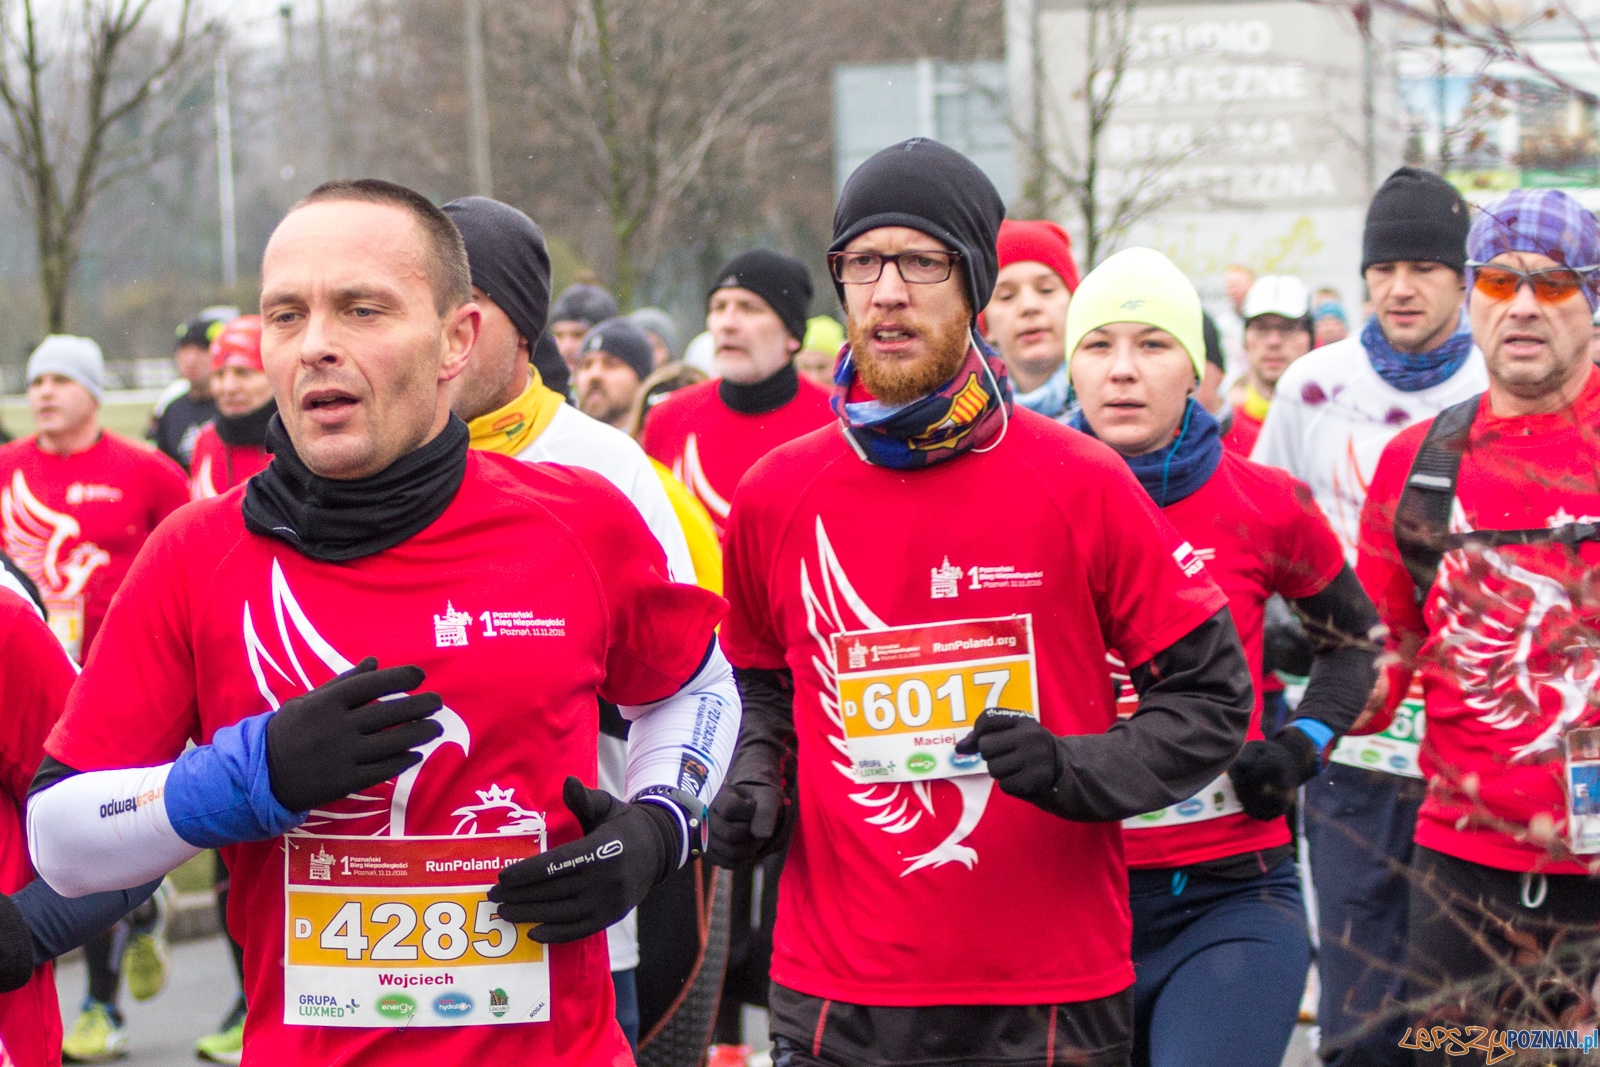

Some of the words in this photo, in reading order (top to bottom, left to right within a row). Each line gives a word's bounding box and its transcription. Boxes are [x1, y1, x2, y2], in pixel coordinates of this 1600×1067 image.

[967, 566, 982, 590] 1
[492, 610, 534, 619] Poznański
[479, 611, 497, 637] 1
[493, 619, 512, 627] Bieg
[933, 636, 1016, 653] RunPoland.org
[870, 645, 881, 662] 1
[844, 701, 858, 717] D
[862, 669, 1011, 731] 6017
[913, 734, 957, 747] Maciej
[341, 856, 351, 875] 1
[425, 856, 526, 872] RunPoland.or
[547, 852, 595, 875] Kalenji
[294, 918, 313, 939] D
[319, 901, 519, 961] 4285
[378, 973, 455, 988] Wojciech
[299, 994, 338, 1006] GRUPA
[299, 1005, 345, 1018] LUXMED
[381, 1003, 413, 1014] energy
